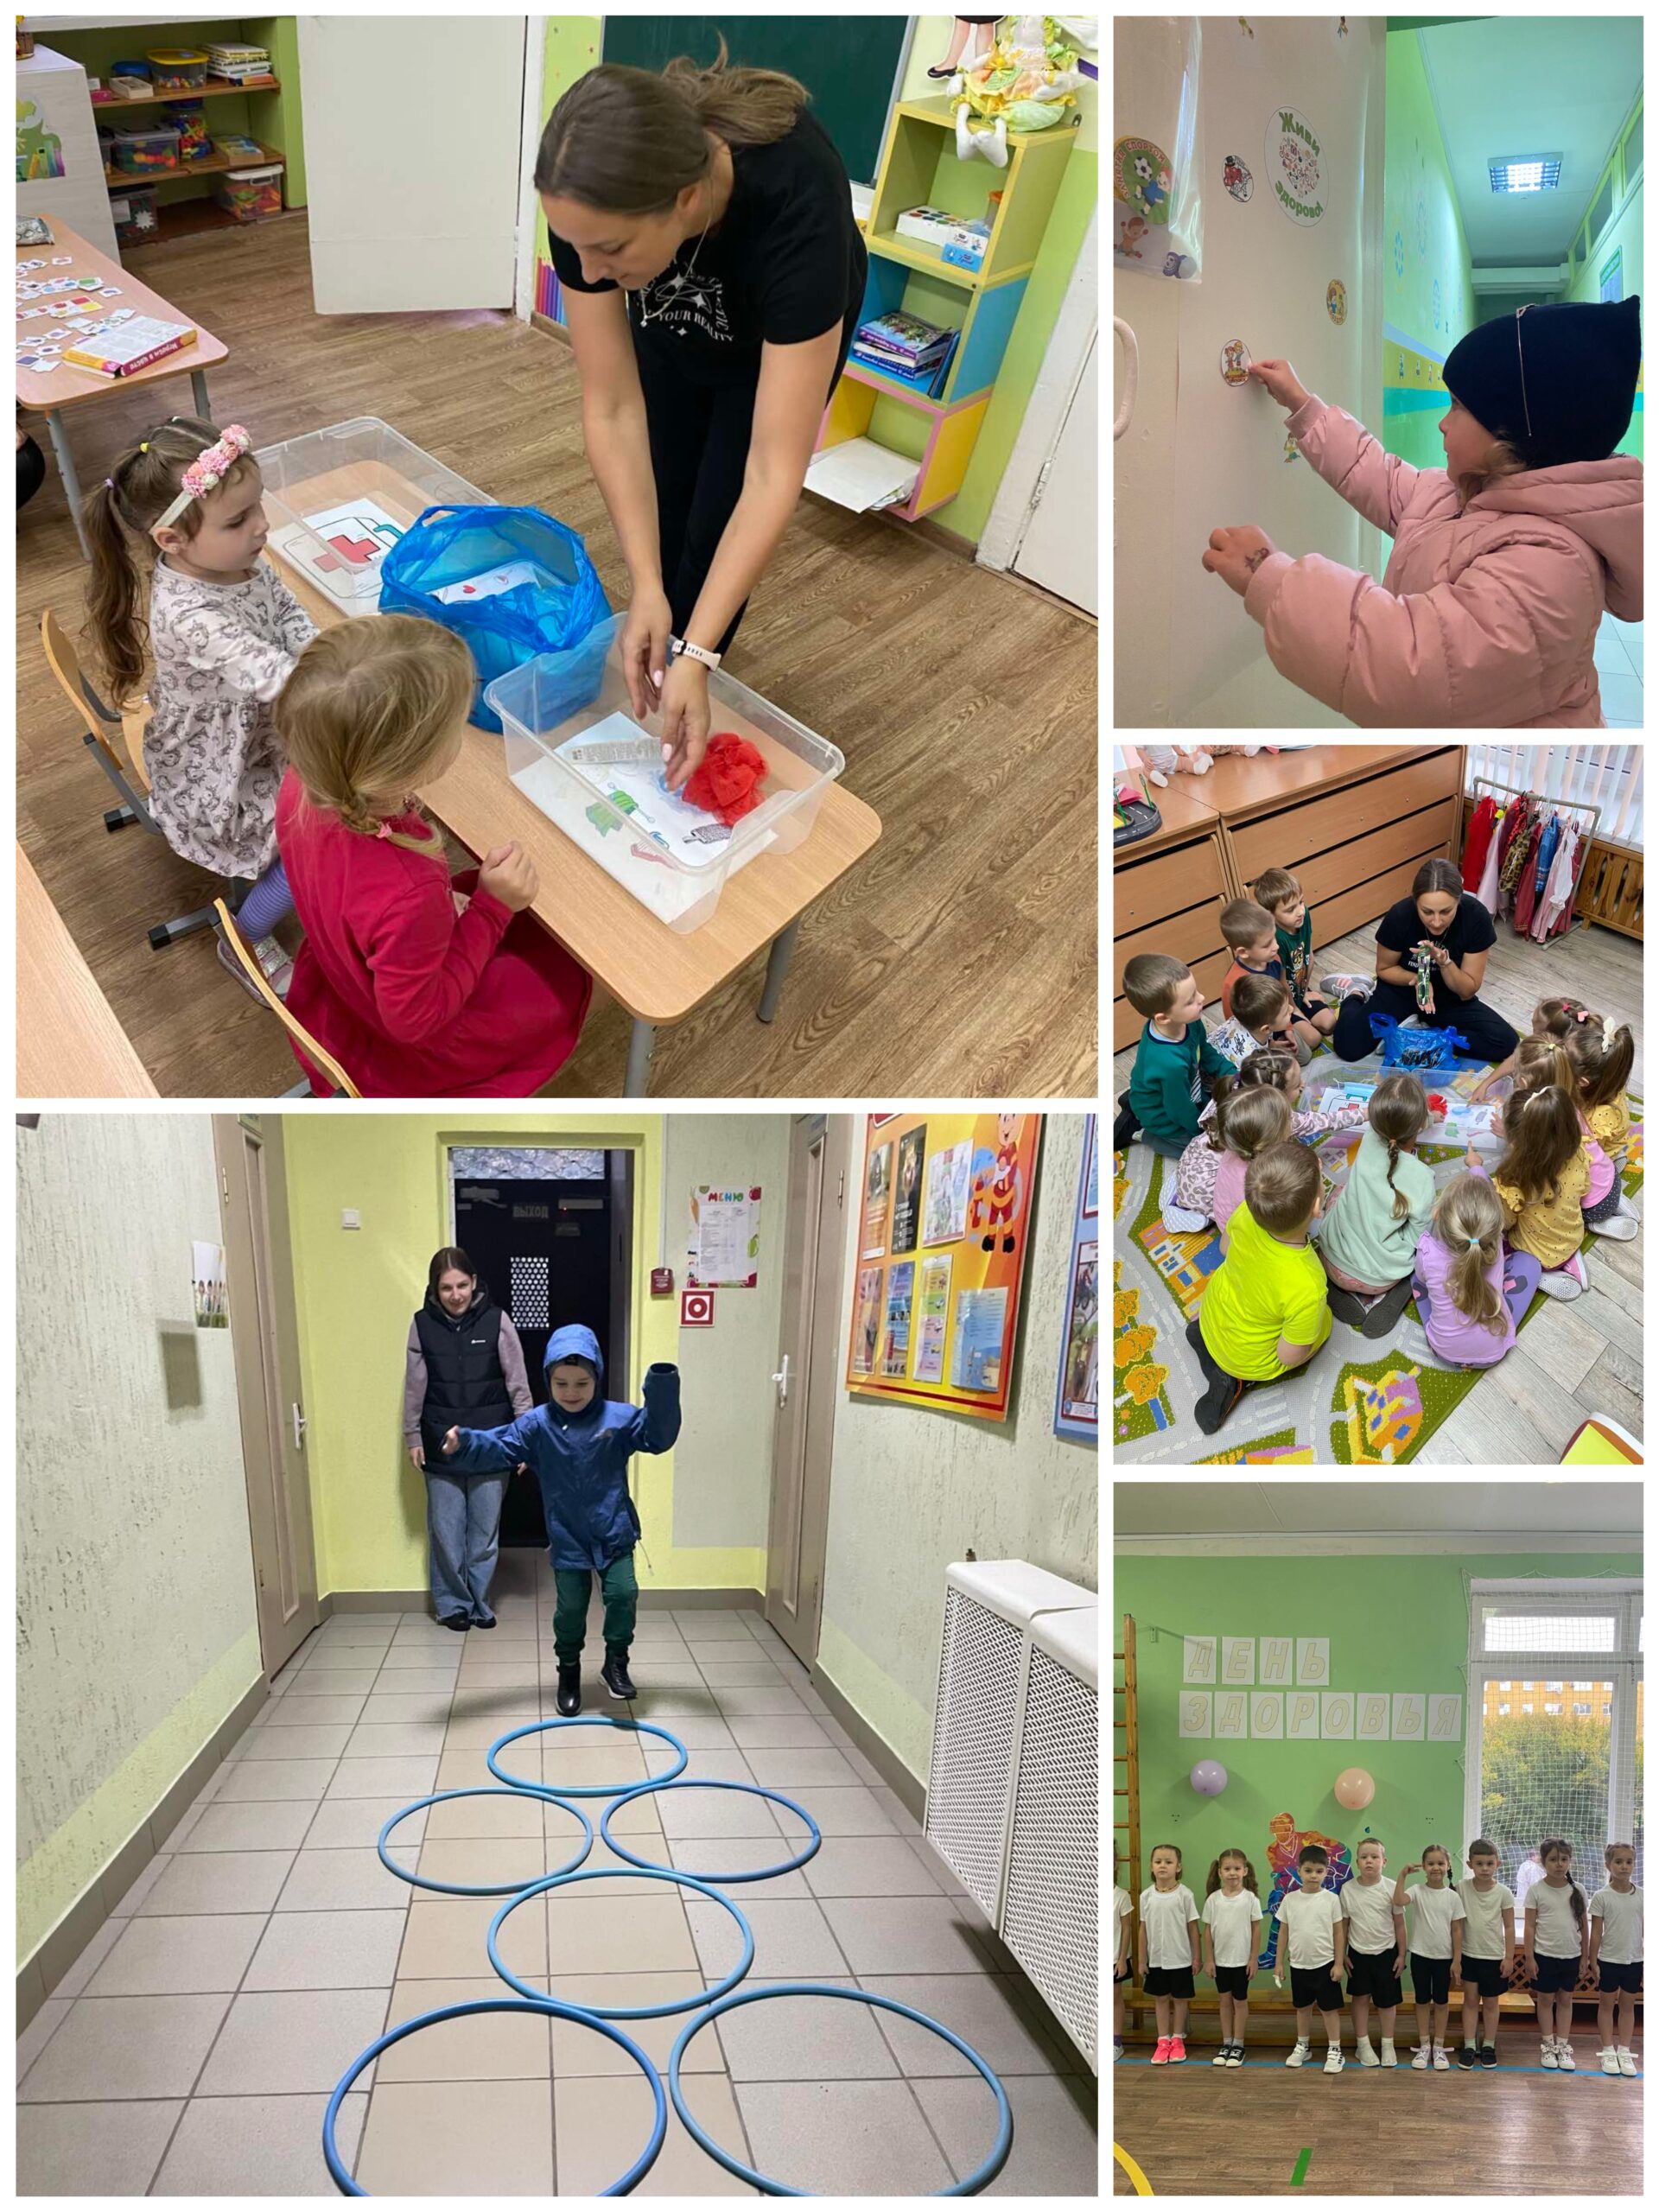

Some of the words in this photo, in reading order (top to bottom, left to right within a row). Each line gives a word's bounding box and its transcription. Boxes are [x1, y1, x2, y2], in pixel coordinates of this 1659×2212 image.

[1279, 111, 1320, 156] Живи
[1126, 140, 1166, 162] СПОРТОМ
[658, 310, 691, 321] YOUR
[694, 312, 734, 342] REALITY
[512, 1205, 549, 1219] ВЫХОД
[709, 1192, 744, 1202] МЕНЮ
[1187, 1640, 1326, 1680] ДЕНЬ
[1182, 1695, 1459, 1736] ЗДОРОВЬЯ
